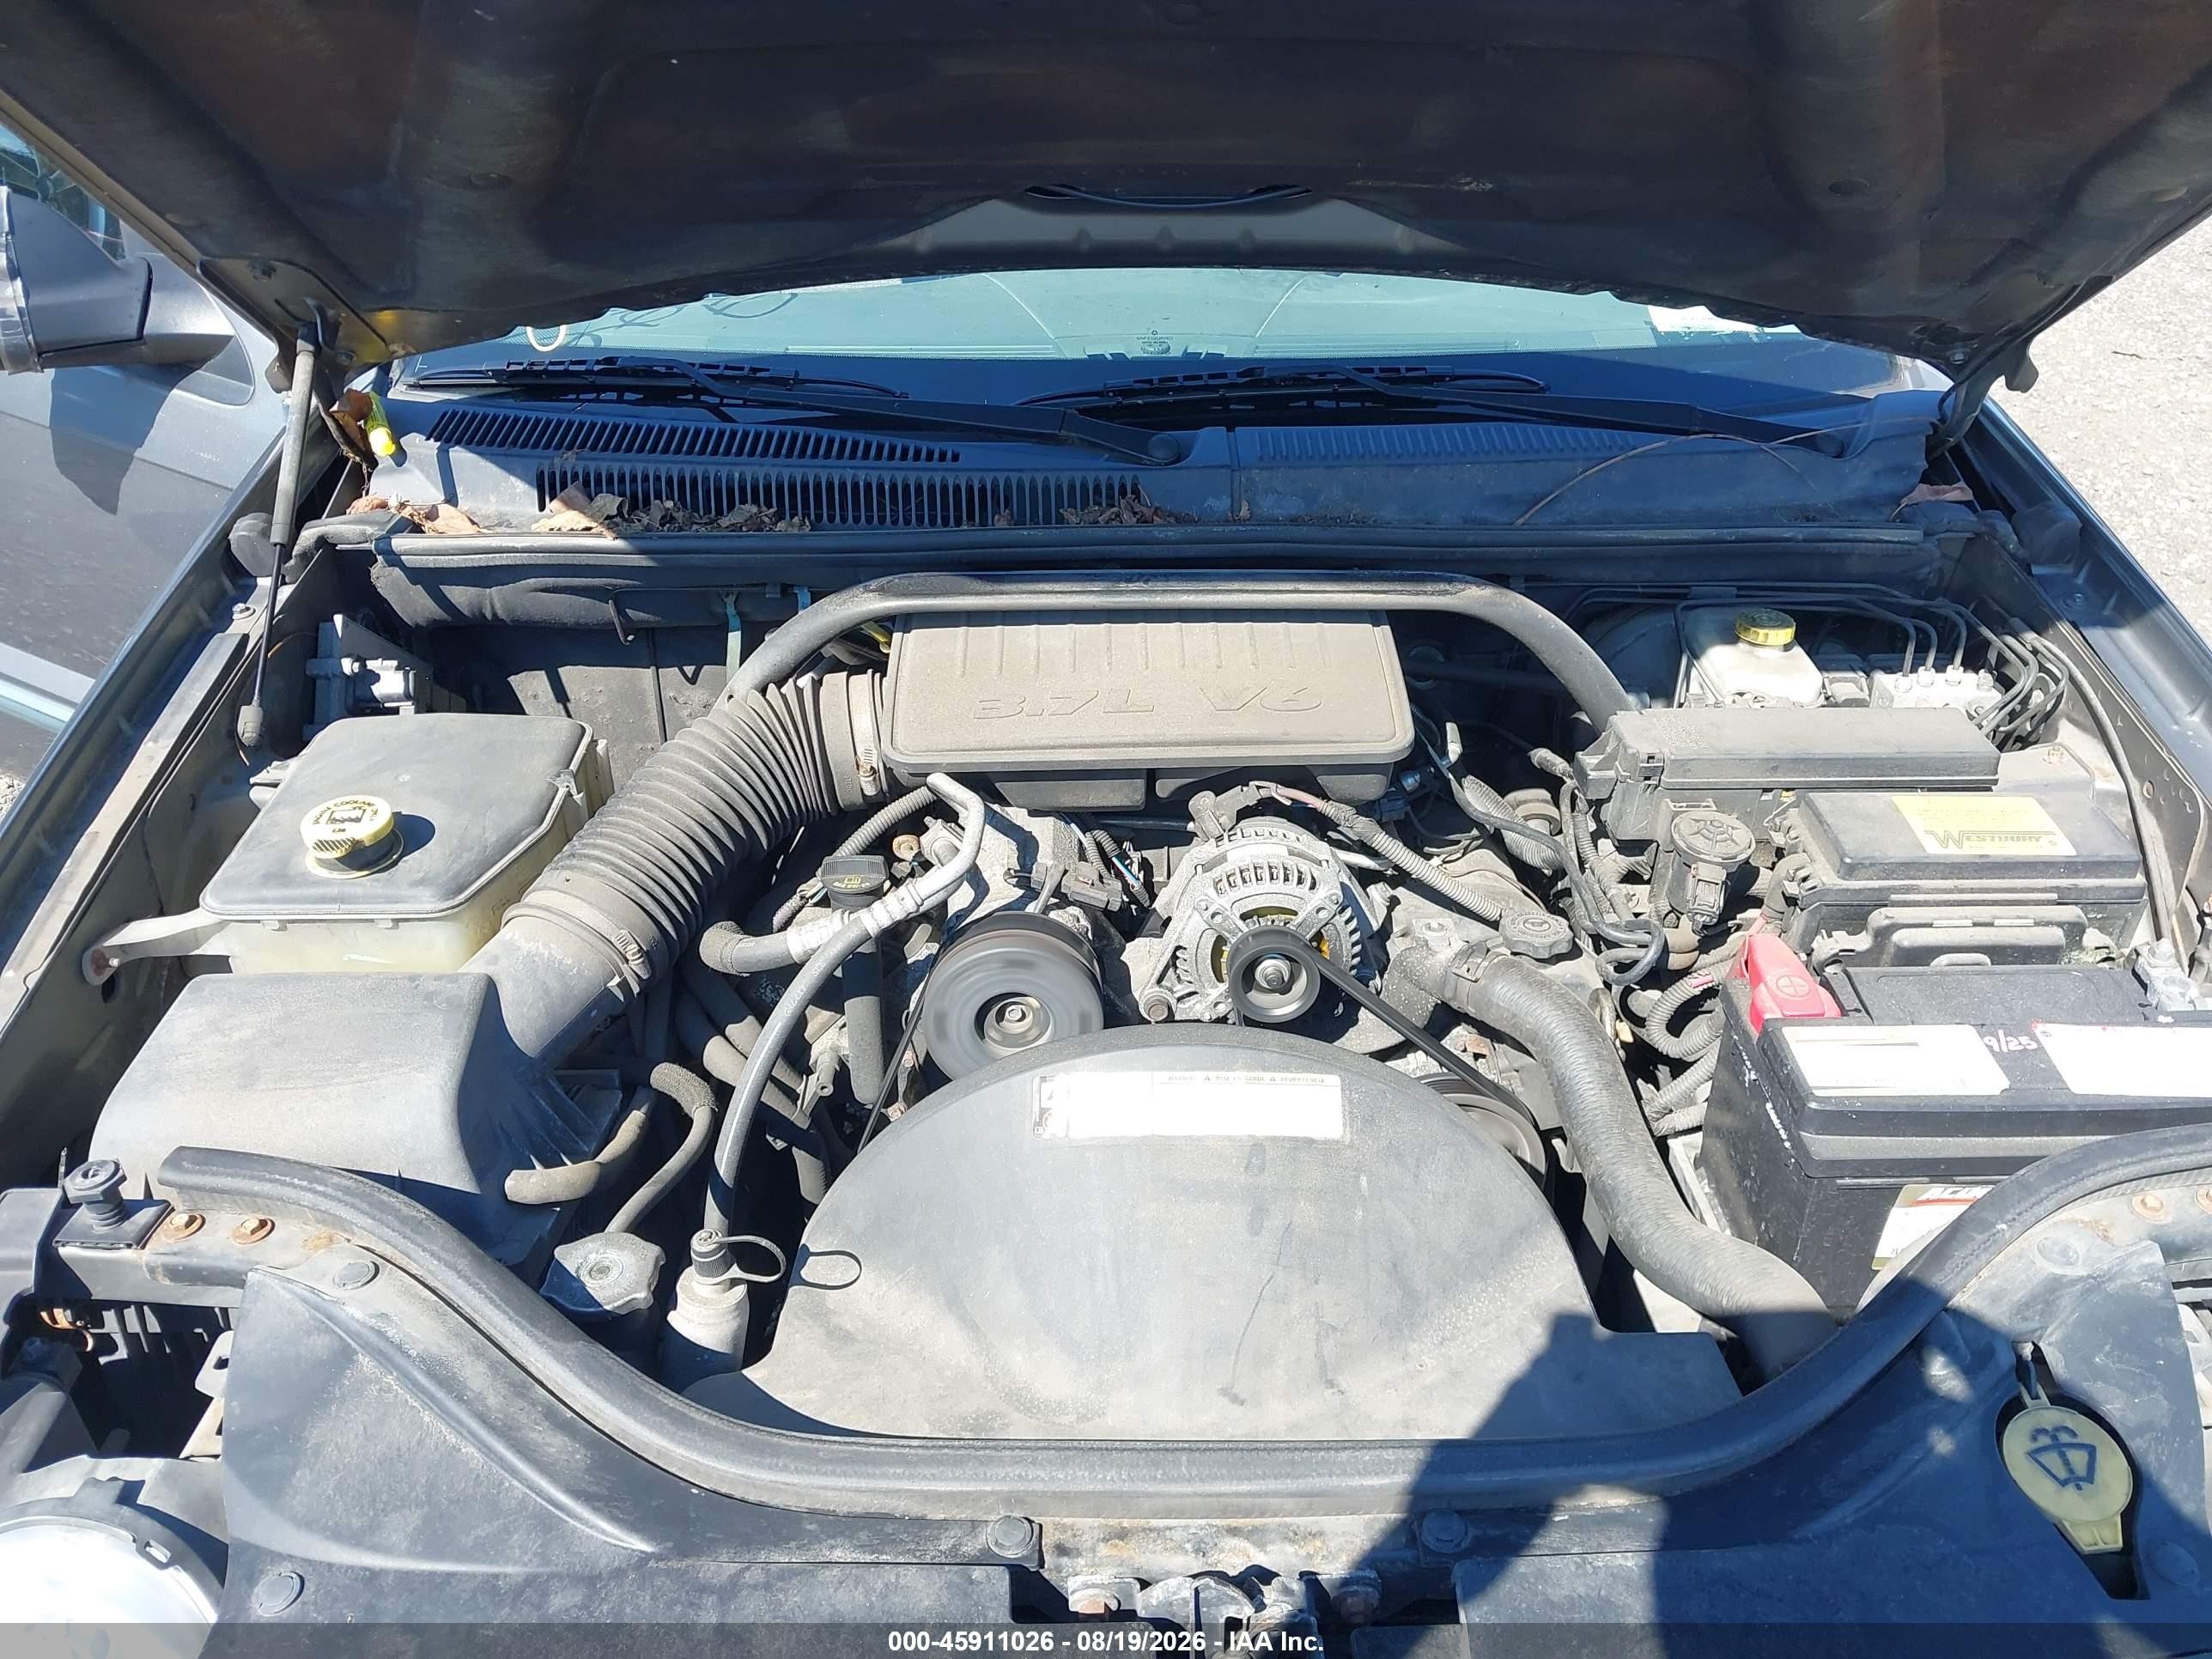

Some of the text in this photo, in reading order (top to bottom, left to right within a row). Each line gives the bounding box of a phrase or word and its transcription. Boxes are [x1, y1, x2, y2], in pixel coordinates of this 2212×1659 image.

[973, 684, 1324, 720] 3.7L V6
[1983, 1029, 2039, 1053] 9/25
